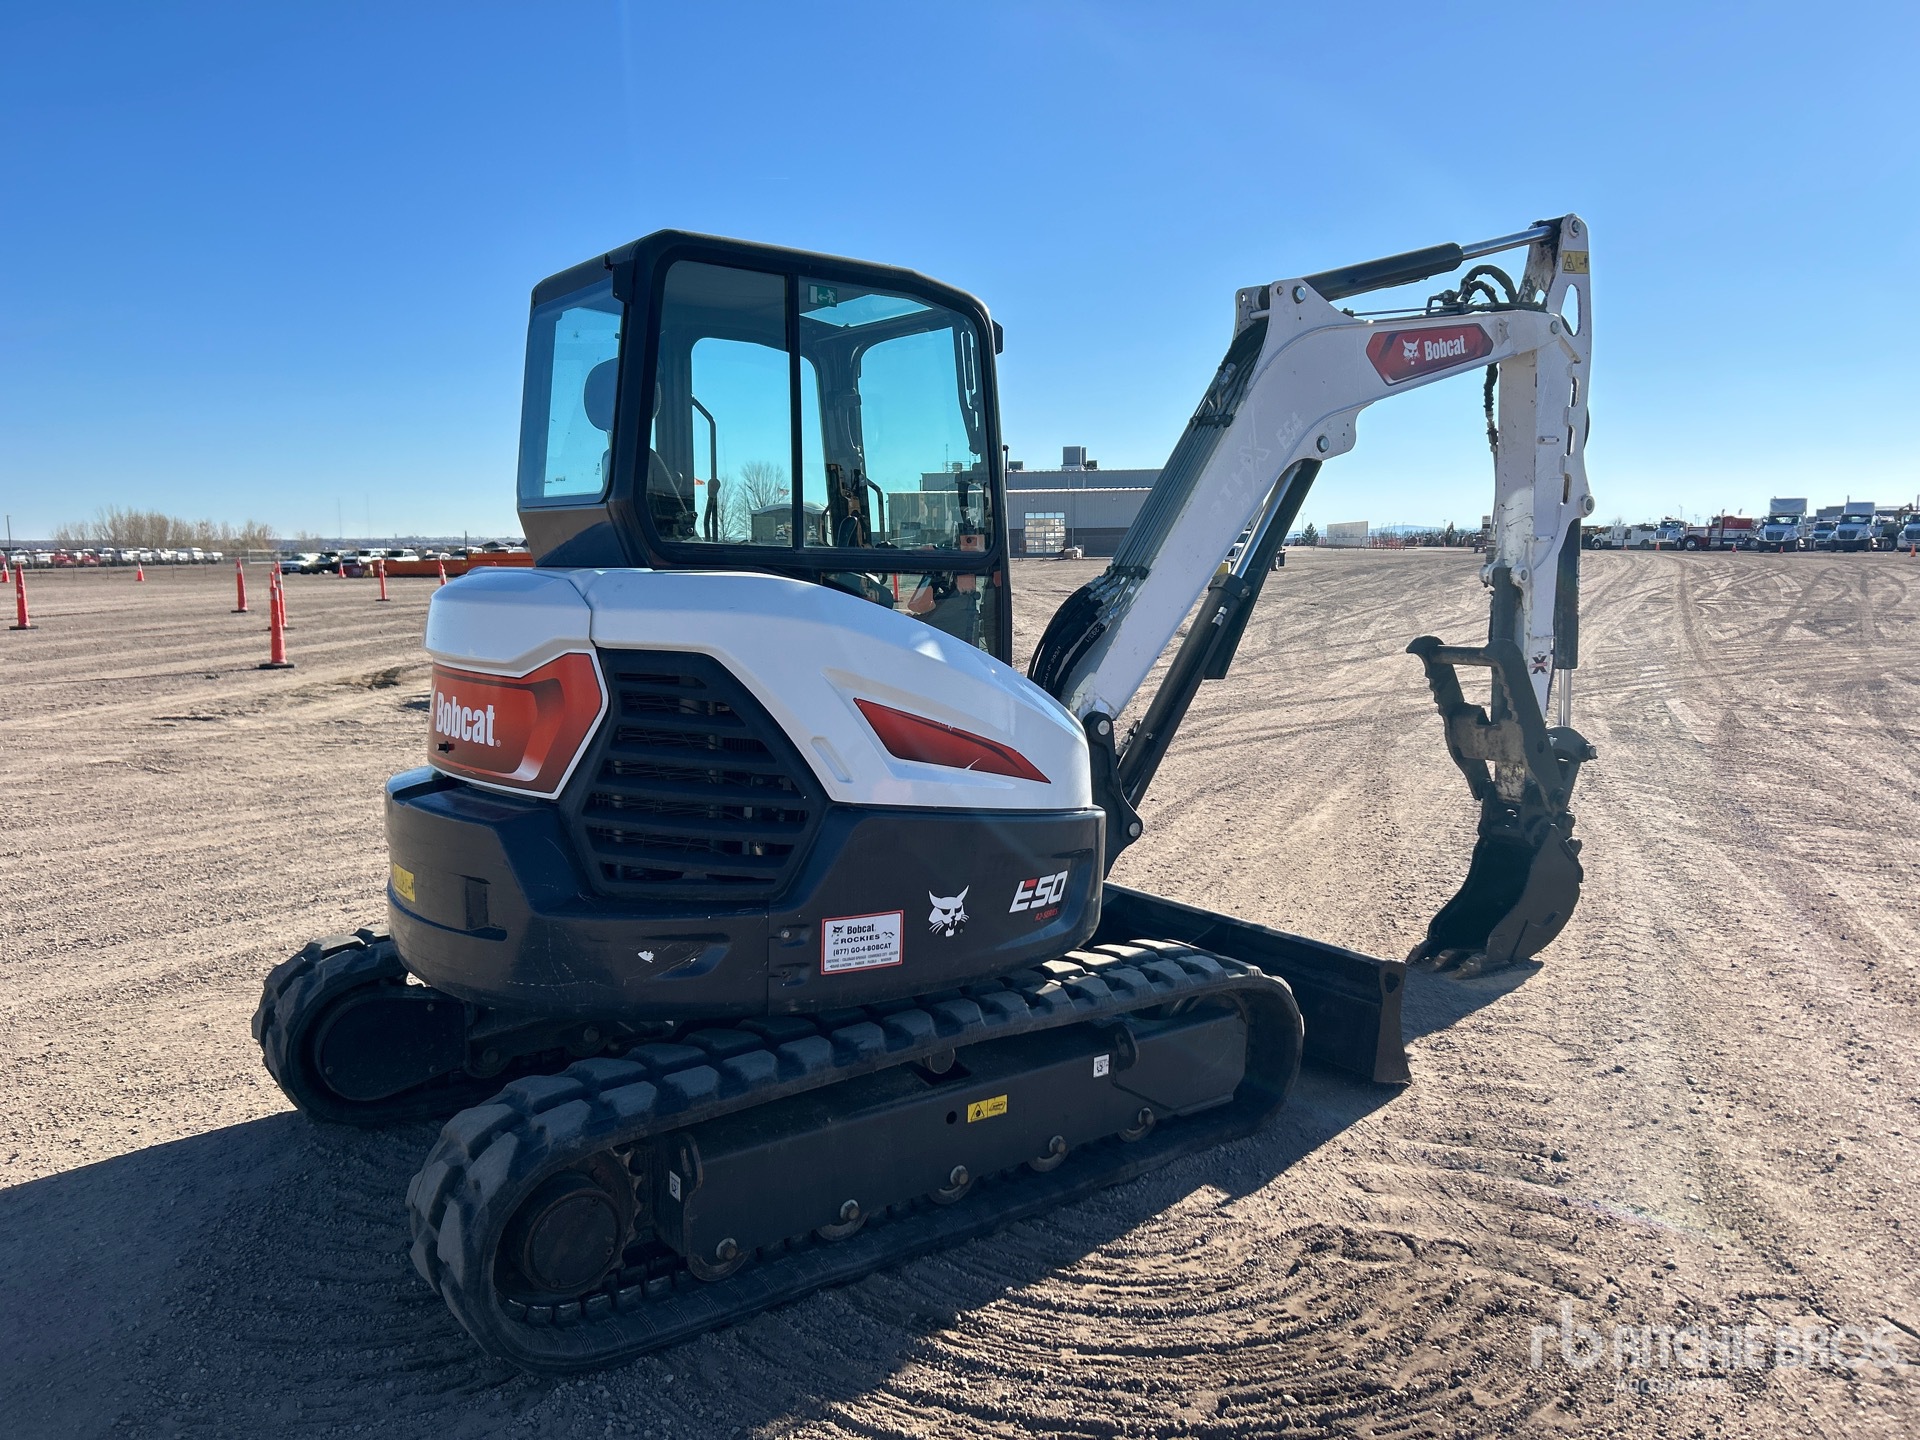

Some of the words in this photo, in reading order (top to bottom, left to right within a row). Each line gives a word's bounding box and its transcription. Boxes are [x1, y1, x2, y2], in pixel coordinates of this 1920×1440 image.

[1424, 335, 1466, 361] Bobcat
[436, 691, 495, 746] Bobcat
[1009, 870, 1068, 914] E50
[840, 934, 880, 944] ROCKIES
[847, 923, 875, 935] Bobcat
[833, 948, 849, 957] (877)
[851, 942, 892, 954] GO-4-BOBCAT
